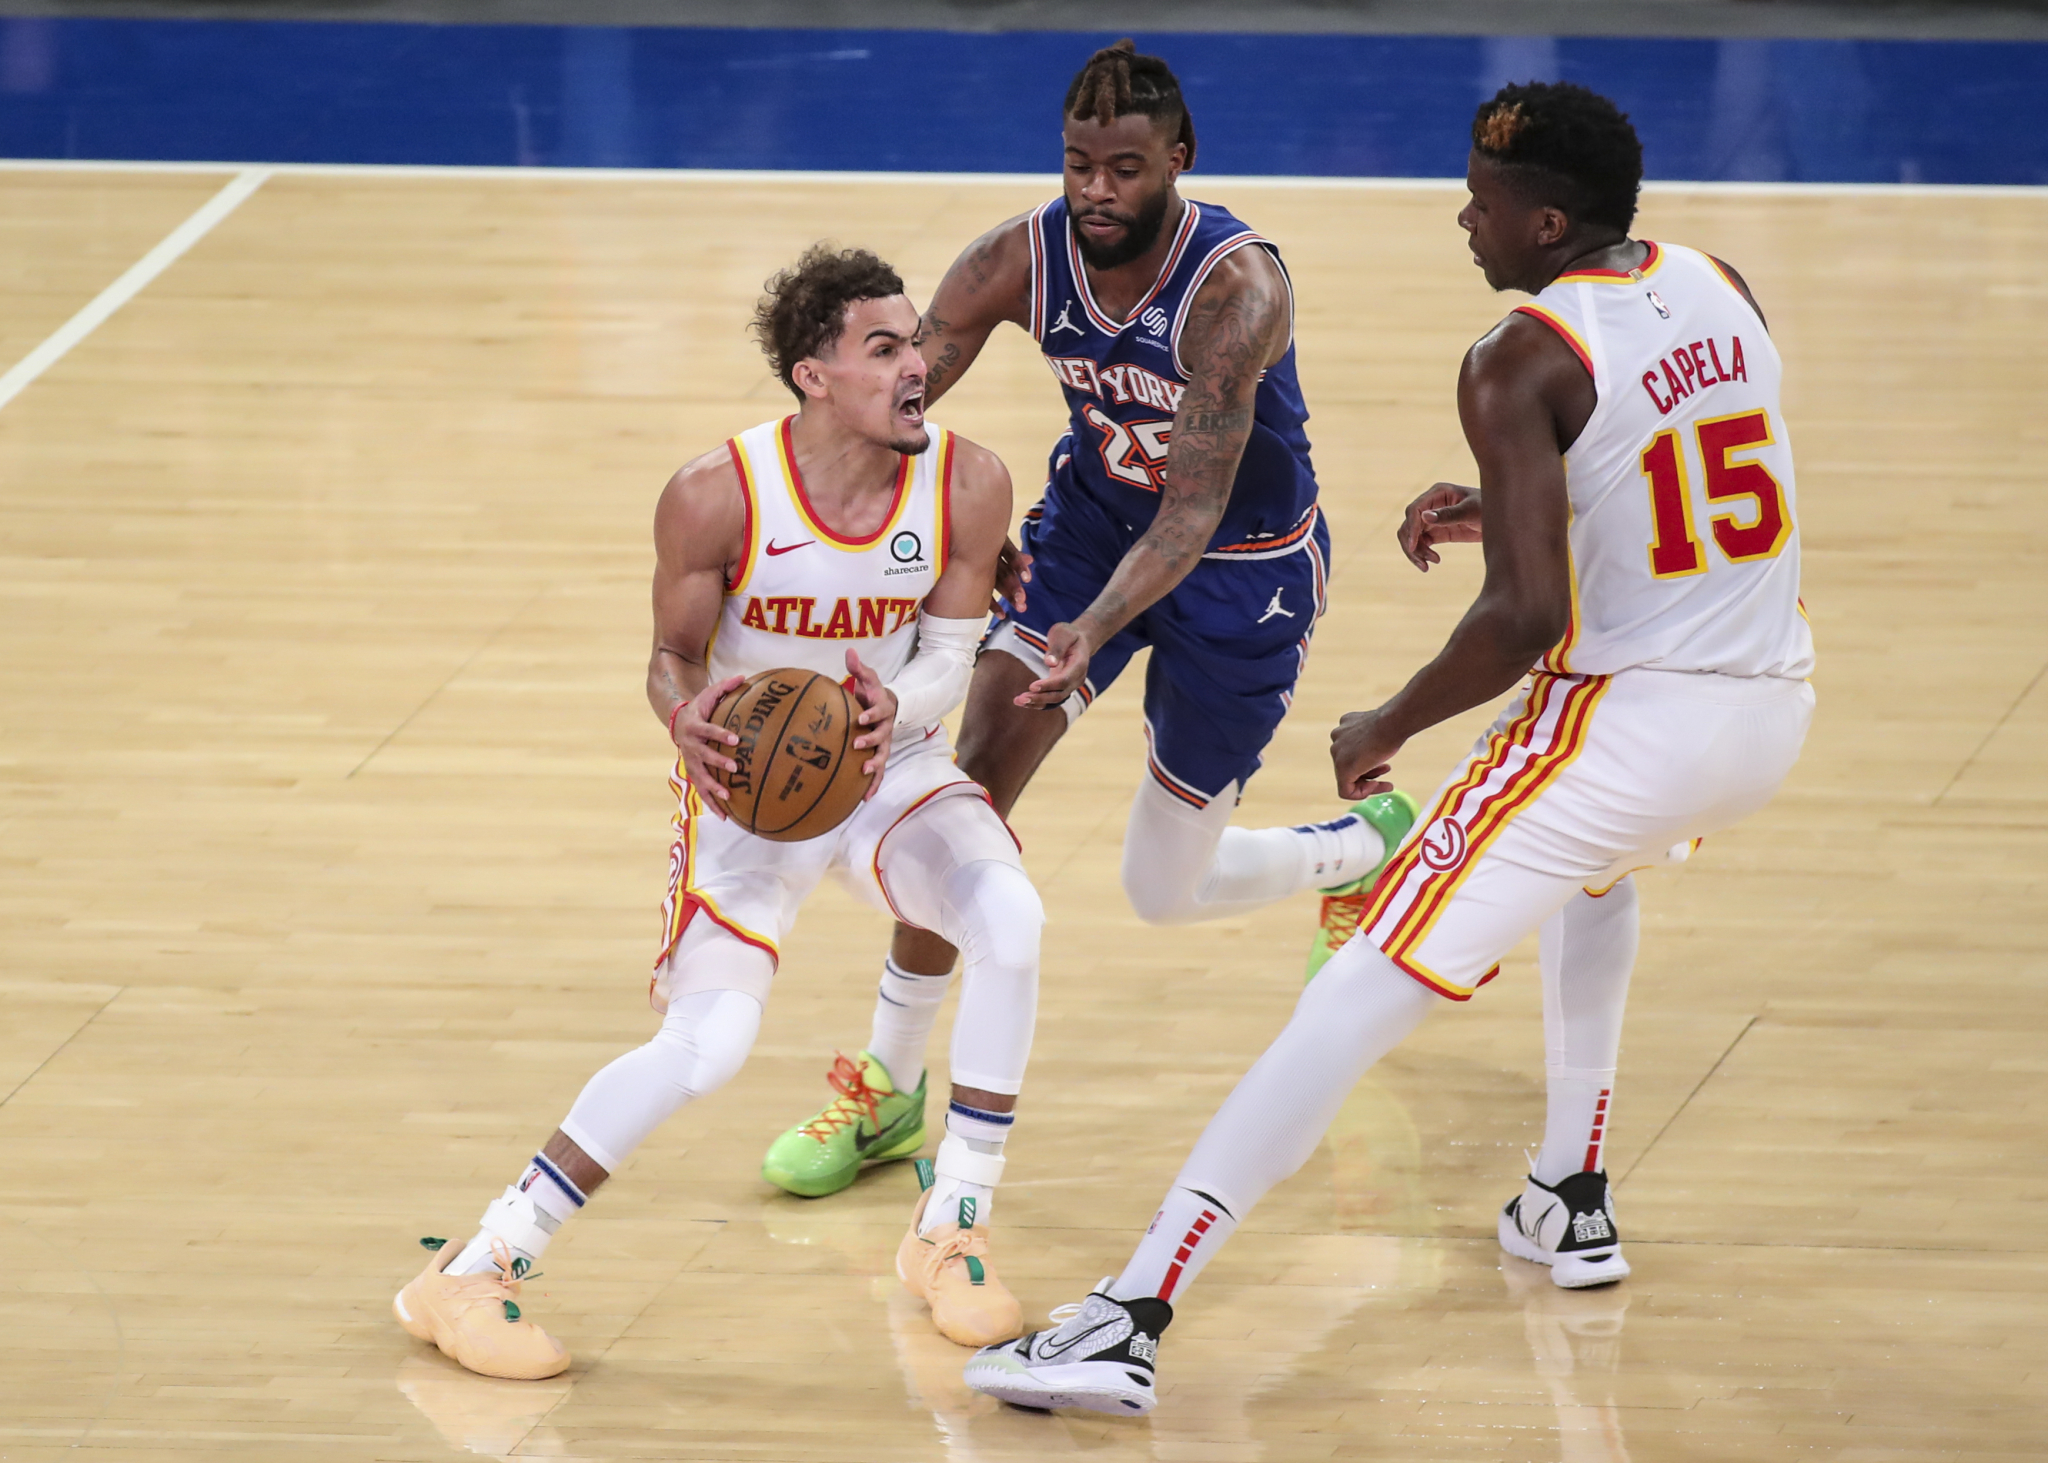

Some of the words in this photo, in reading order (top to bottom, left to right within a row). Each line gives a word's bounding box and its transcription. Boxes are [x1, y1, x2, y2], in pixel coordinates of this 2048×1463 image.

[1098, 363, 1187, 413] YORK
[1642, 336, 1747, 415] CAPELA
[1082, 403, 1173, 492] 25
[1640, 407, 1794, 580] 15
[884, 565, 929, 576] sharecare
[728, 681, 796, 794] SPALDING
